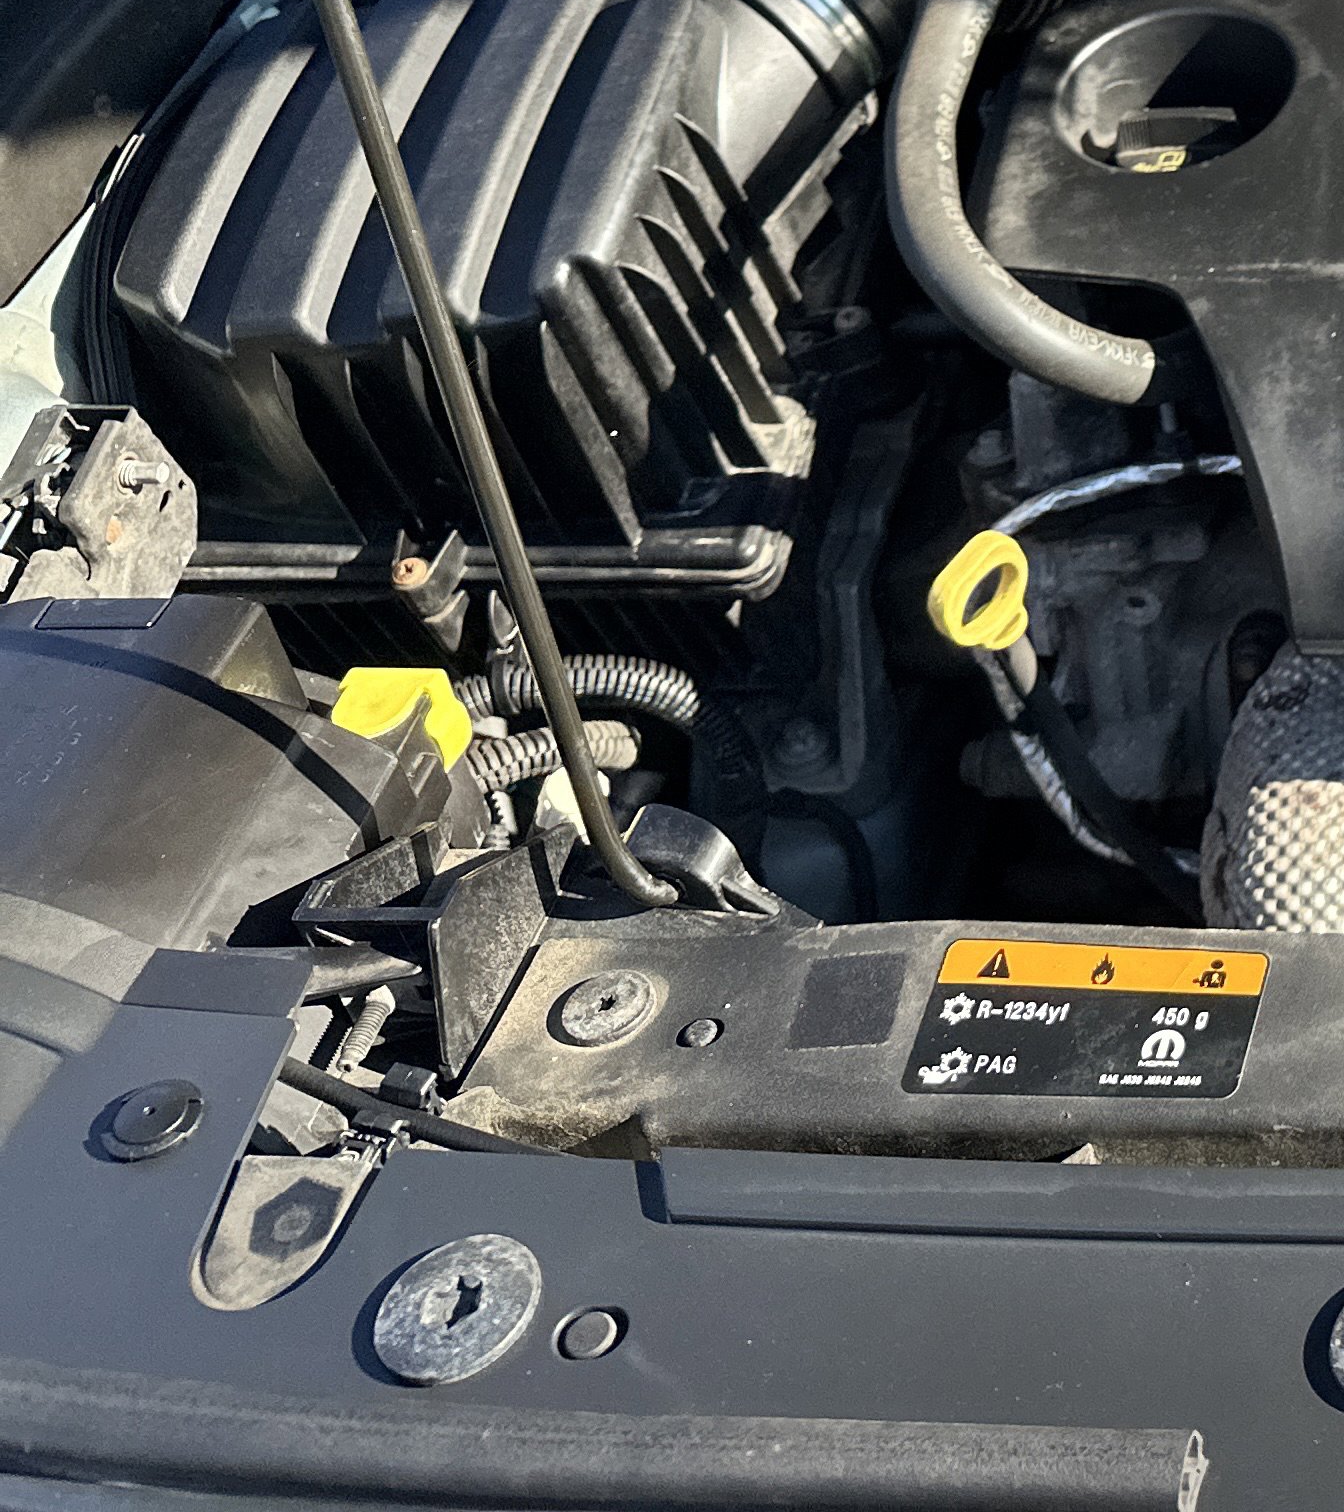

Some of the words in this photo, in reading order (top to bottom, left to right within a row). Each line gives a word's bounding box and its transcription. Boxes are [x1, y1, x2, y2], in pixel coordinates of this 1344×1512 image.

[975, 999, 1070, 1025] R-1234yf
[1151, 1006, 1190, 1026] 450
[1194, 1011, 1209, 1031] g
[973, 1054, 1017, 1075] PAG
